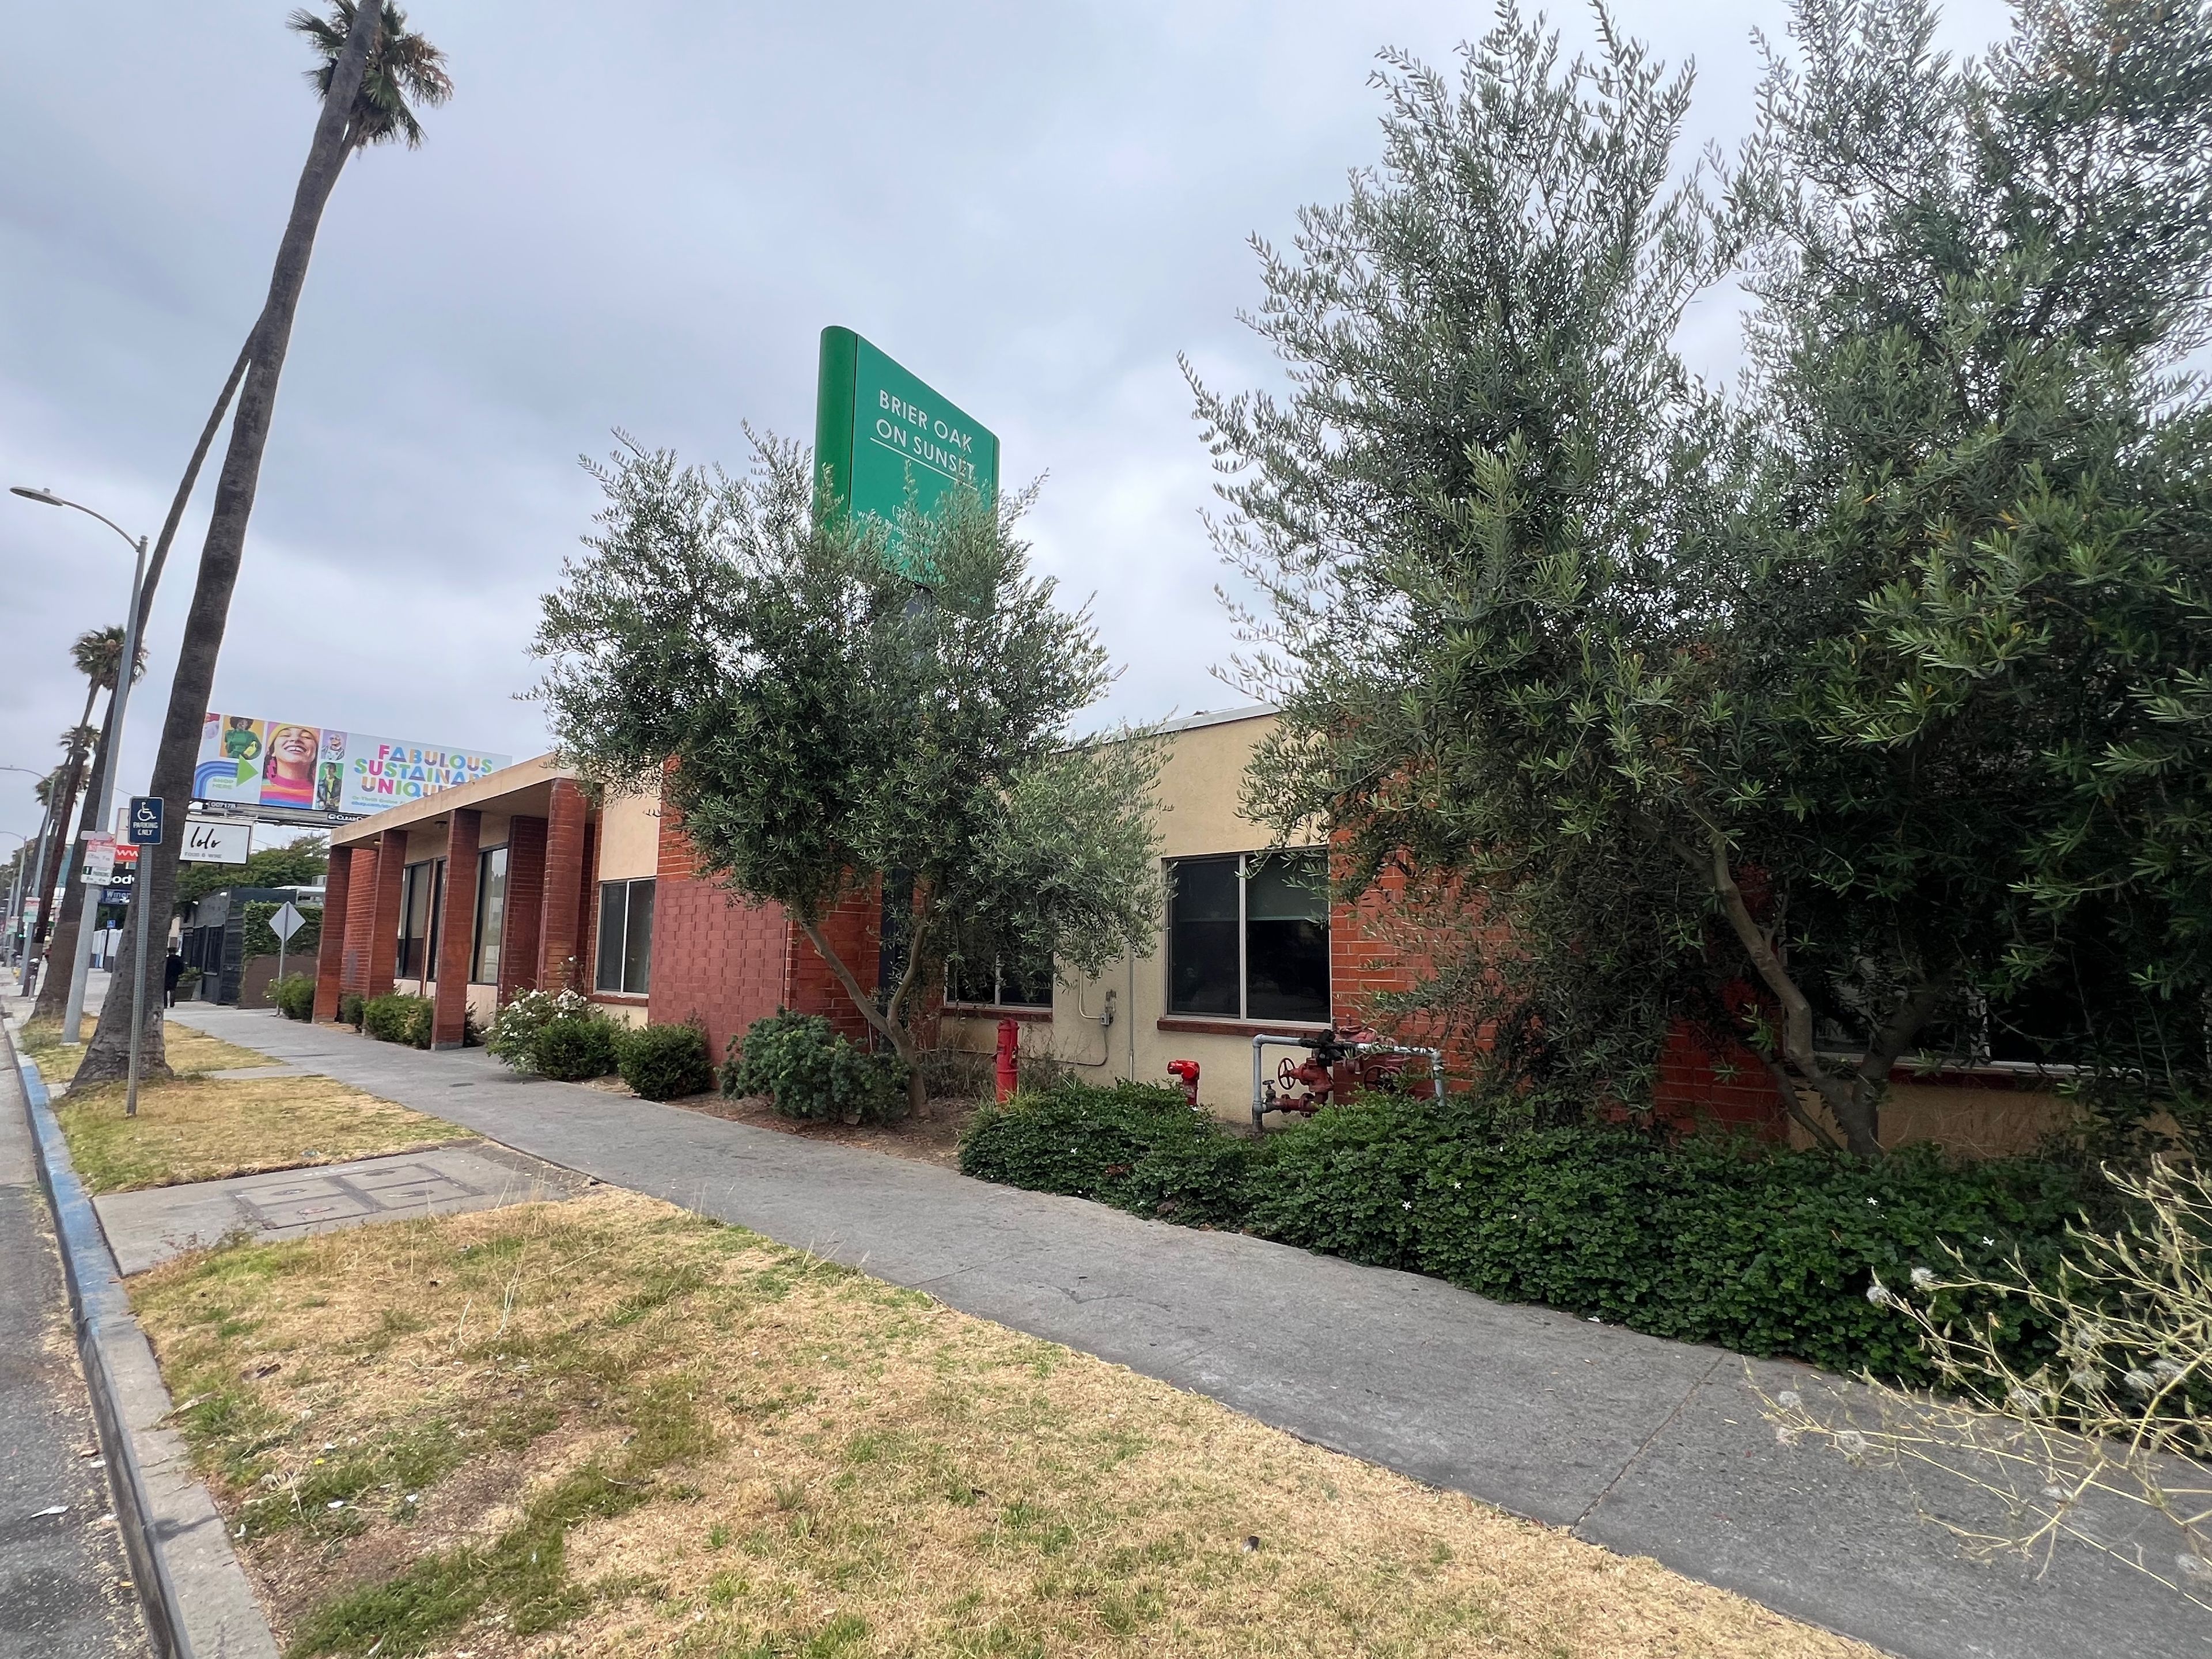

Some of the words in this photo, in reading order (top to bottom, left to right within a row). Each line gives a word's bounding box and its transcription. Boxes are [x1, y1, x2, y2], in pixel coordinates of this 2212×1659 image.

[876, 418, 907, 448] ON
[913, 435, 975, 480] SUNSET
[879, 389, 928, 430] BRIER
[934, 419, 973, 453] OAK
[378, 744, 493, 773] FABULOUS
